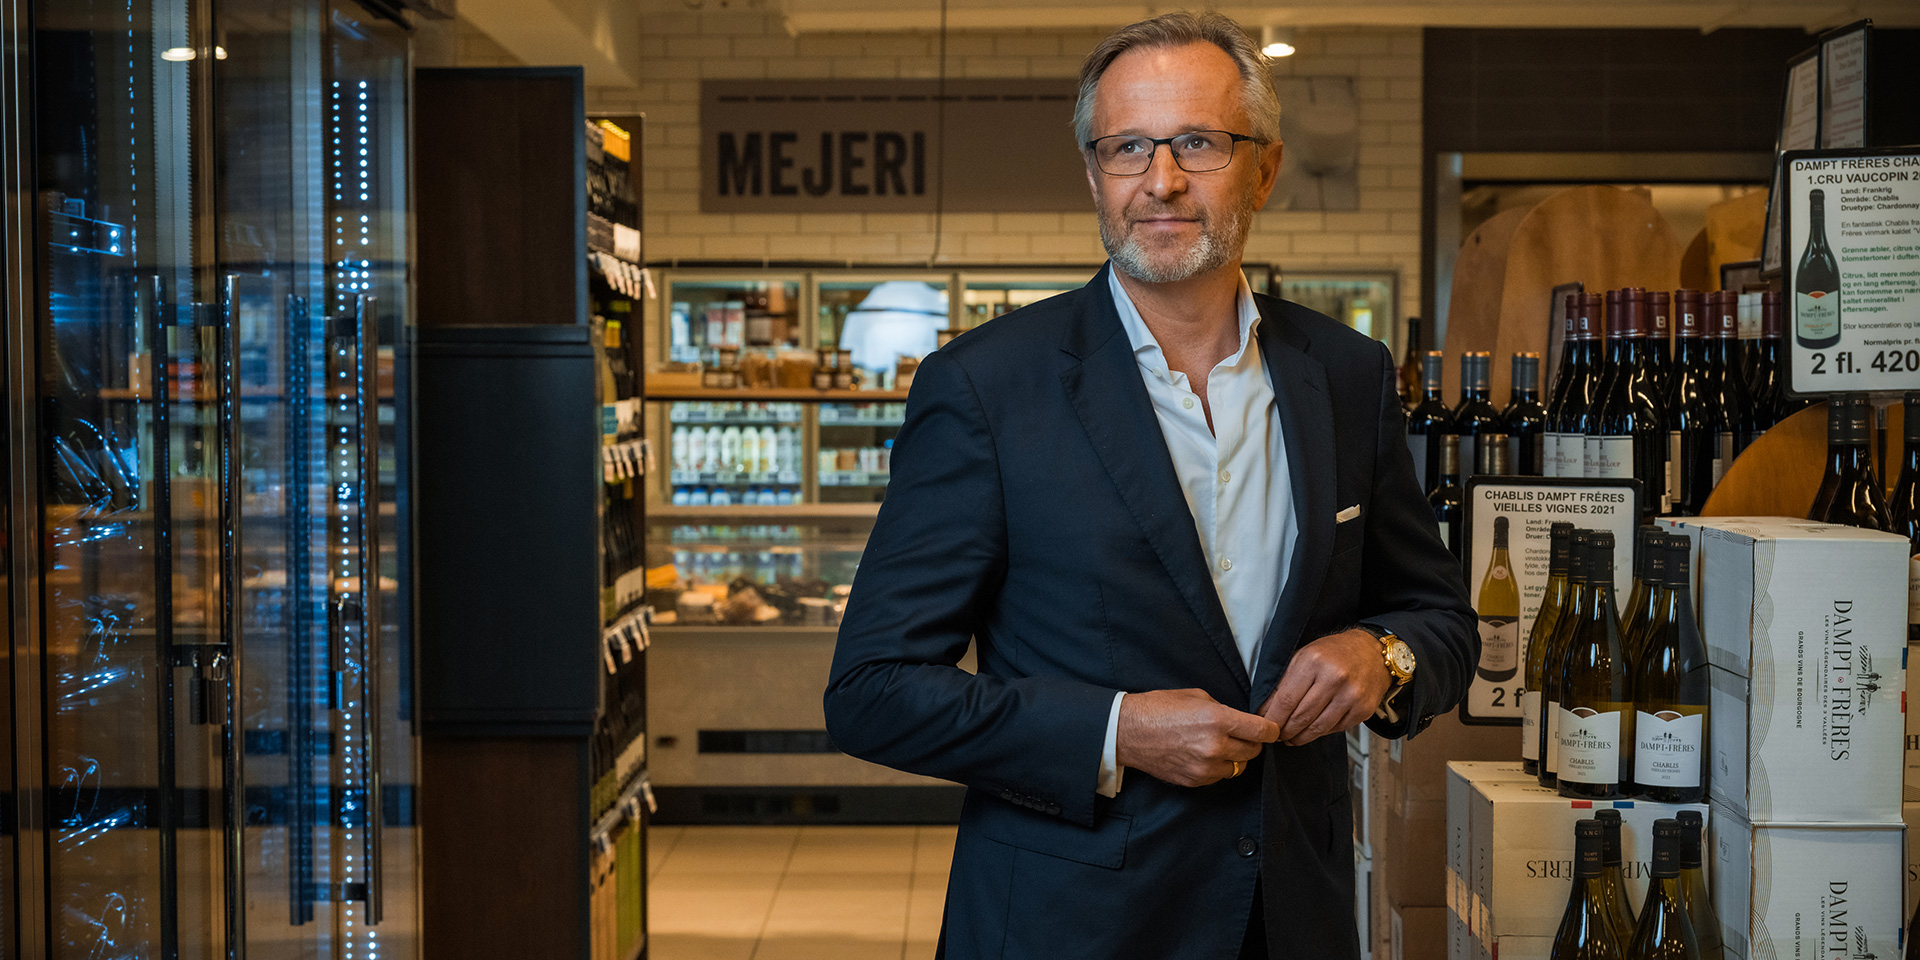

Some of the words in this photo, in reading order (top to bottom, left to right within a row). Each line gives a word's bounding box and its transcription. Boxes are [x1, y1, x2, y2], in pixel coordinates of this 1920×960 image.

[718, 131, 925, 197] MEJERI
[1795, 160, 1838, 171] DAMPT
[1808, 174, 1843, 185] 1.CRU
[1846, 171, 1908, 183] VAUCOPIN
[1912, 171, 1920, 181] 2
[1862, 187, 1892, 195] Frankrig
[1841, 195, 1871, 203] Område:
[1841, 204, 1875, 212] Druetype:
[1877, 202, 1920, 210] Chardonnay
[1852, 220, 1883, 228] fantastisk
[1842, 254, 1891, 262] blomstertoner
[1863, 280, 1879, 288] lang
[1858, 321, 1902, 329] koncentration
[1863, 338, 1902, 346] Normalpris
[1811, 352, 1826, 375] 2
[1835, 351, 1861, 374] fl.
[1870, 349, 1920, 373] 420
[1484, 490, 1534, 500] CHABLIS
[1537, 491, 1577, 501] DAMPT
[1579, 491, 1625, 503] FRÉRES
[1493, 503, 1542, 512] VIEILLES
[1545, 503, 1588, 514] VIGNES
[1590, 505, 1615, 514] 2021
[1833, 600, 1853, 675] DAMPT
[1797, 677, 1803, 686] DE
[1491, 687, 1506, 707] 2
[1513, 687, 1526, 707] f
[1830, 687, 1854, 761] FRÈRES
[1560, 737, 1580, 748] DAMPT
[1640, 741, 1665, 751] DAMPT
[1569, 757, 1595, 766] CHABLIS
[1652, 761, 1679, 769] CHABLIS
[1829, 880, 1848, 956] DAMPT
